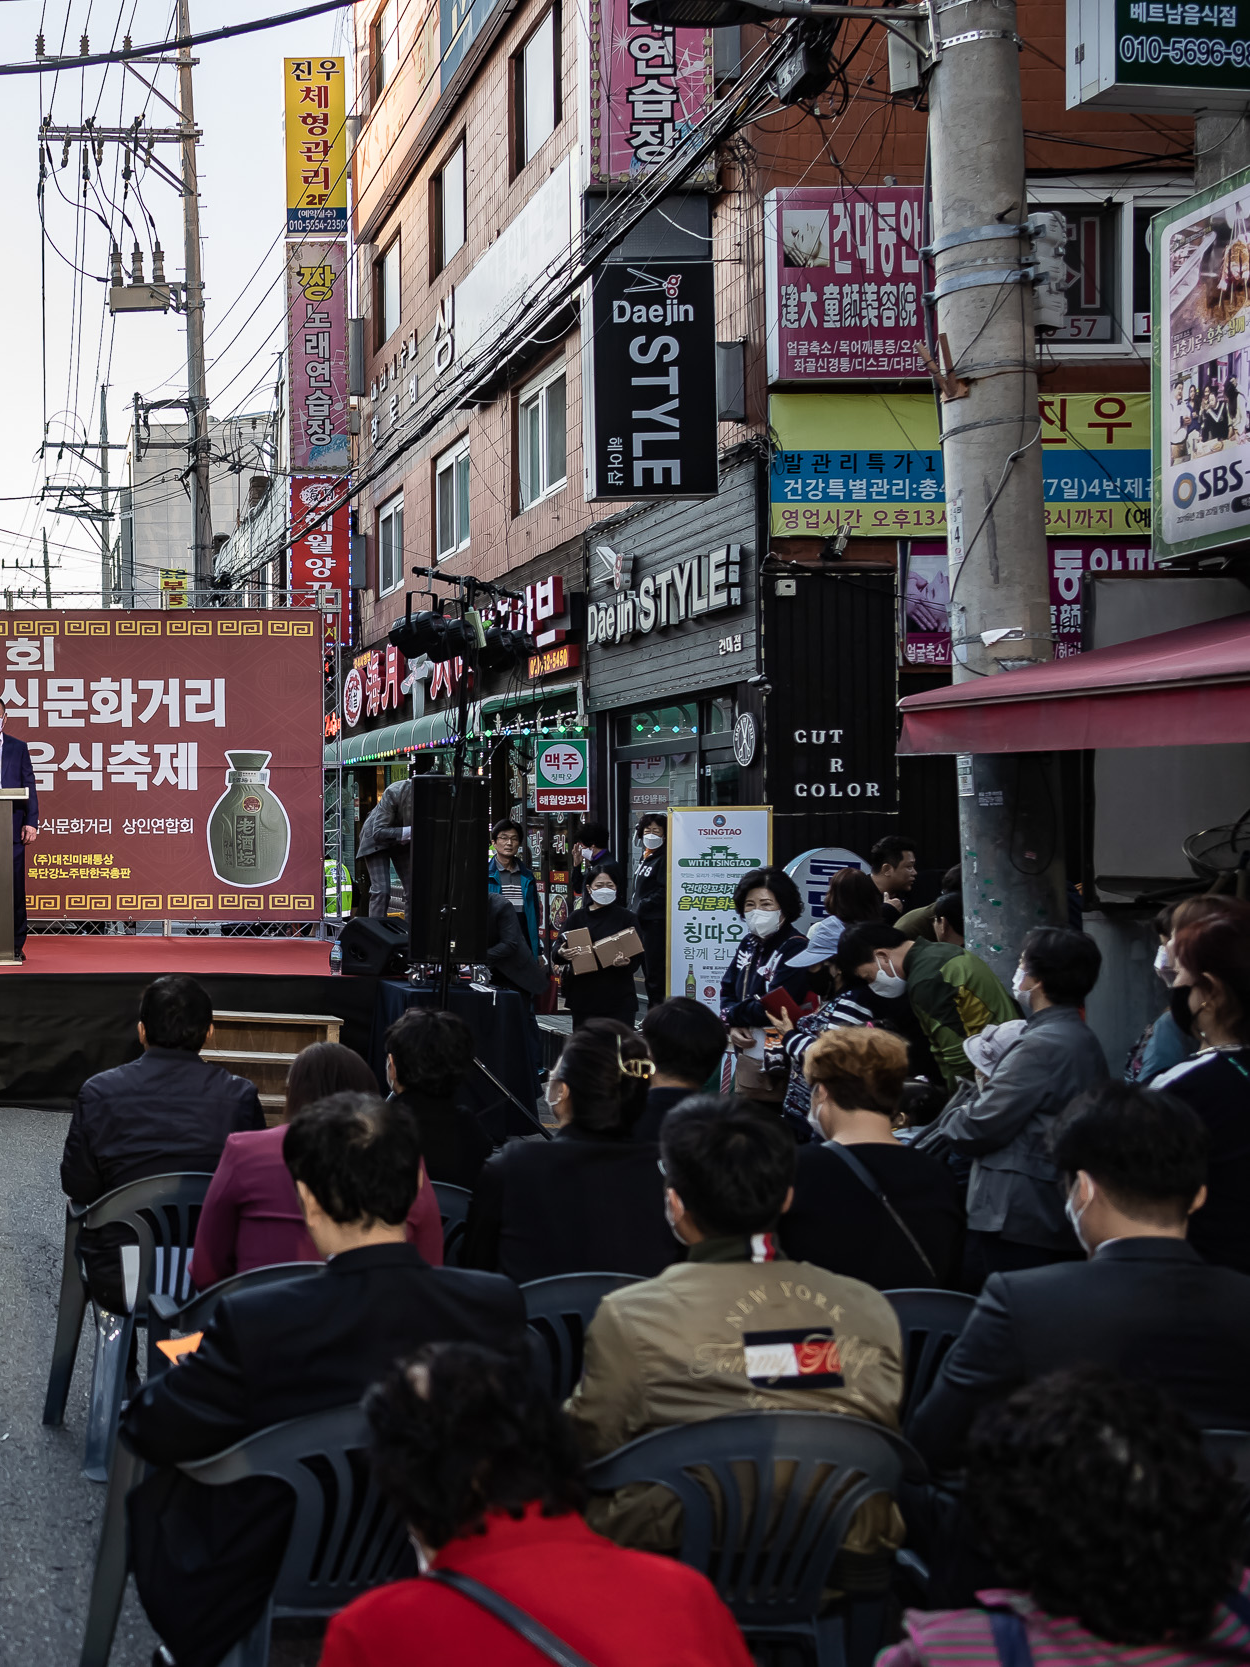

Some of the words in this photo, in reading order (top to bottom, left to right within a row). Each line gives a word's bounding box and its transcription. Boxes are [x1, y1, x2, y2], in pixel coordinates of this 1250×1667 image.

[1130, 2, 1237, 27] 베트남음식점
[291, 60, 340, 81] 진우
[298, 86, 333, 191] 체형관리
[306, 194, 329, 205] 2F
[299, 266, 336, 302] 짱
[613, 299, 694, 325] Daejin
[304, 304, 334, 446] 노래연습장
[629, 335, 681, 487] STYLE
[781, 509, 863, 529] 영업시간
[587, 591, 634, 645] Daejin
[639, 548, 729, 634] STYLE
[6, 637, 55, 672] 회
[718, 634, 743, 655] 건대점
[794, 729, 843, 744] CUT
[545, 753, 580, 770] 맥주
[829, 758, 844, 773] R
[794, 782, 880, 797] COLOR
[538, 794, 586, 806] 해월양꼬치
[122, 818, 194, 835] 상인연합회
[33, 854, 114, 867] (주)대진미래통상
[688, 859, 710, 867] WITH
[711, 859, 751, 867] TSINGTAO
[681, 883, 737, 894] “건대양꼬치거
[683, 922, 744, 944] 칭따오
[683, 947, 709, 960] 함께
[725, 1285, 768, 1328] NEW
[780, 1280, 846, 1323] YORK
